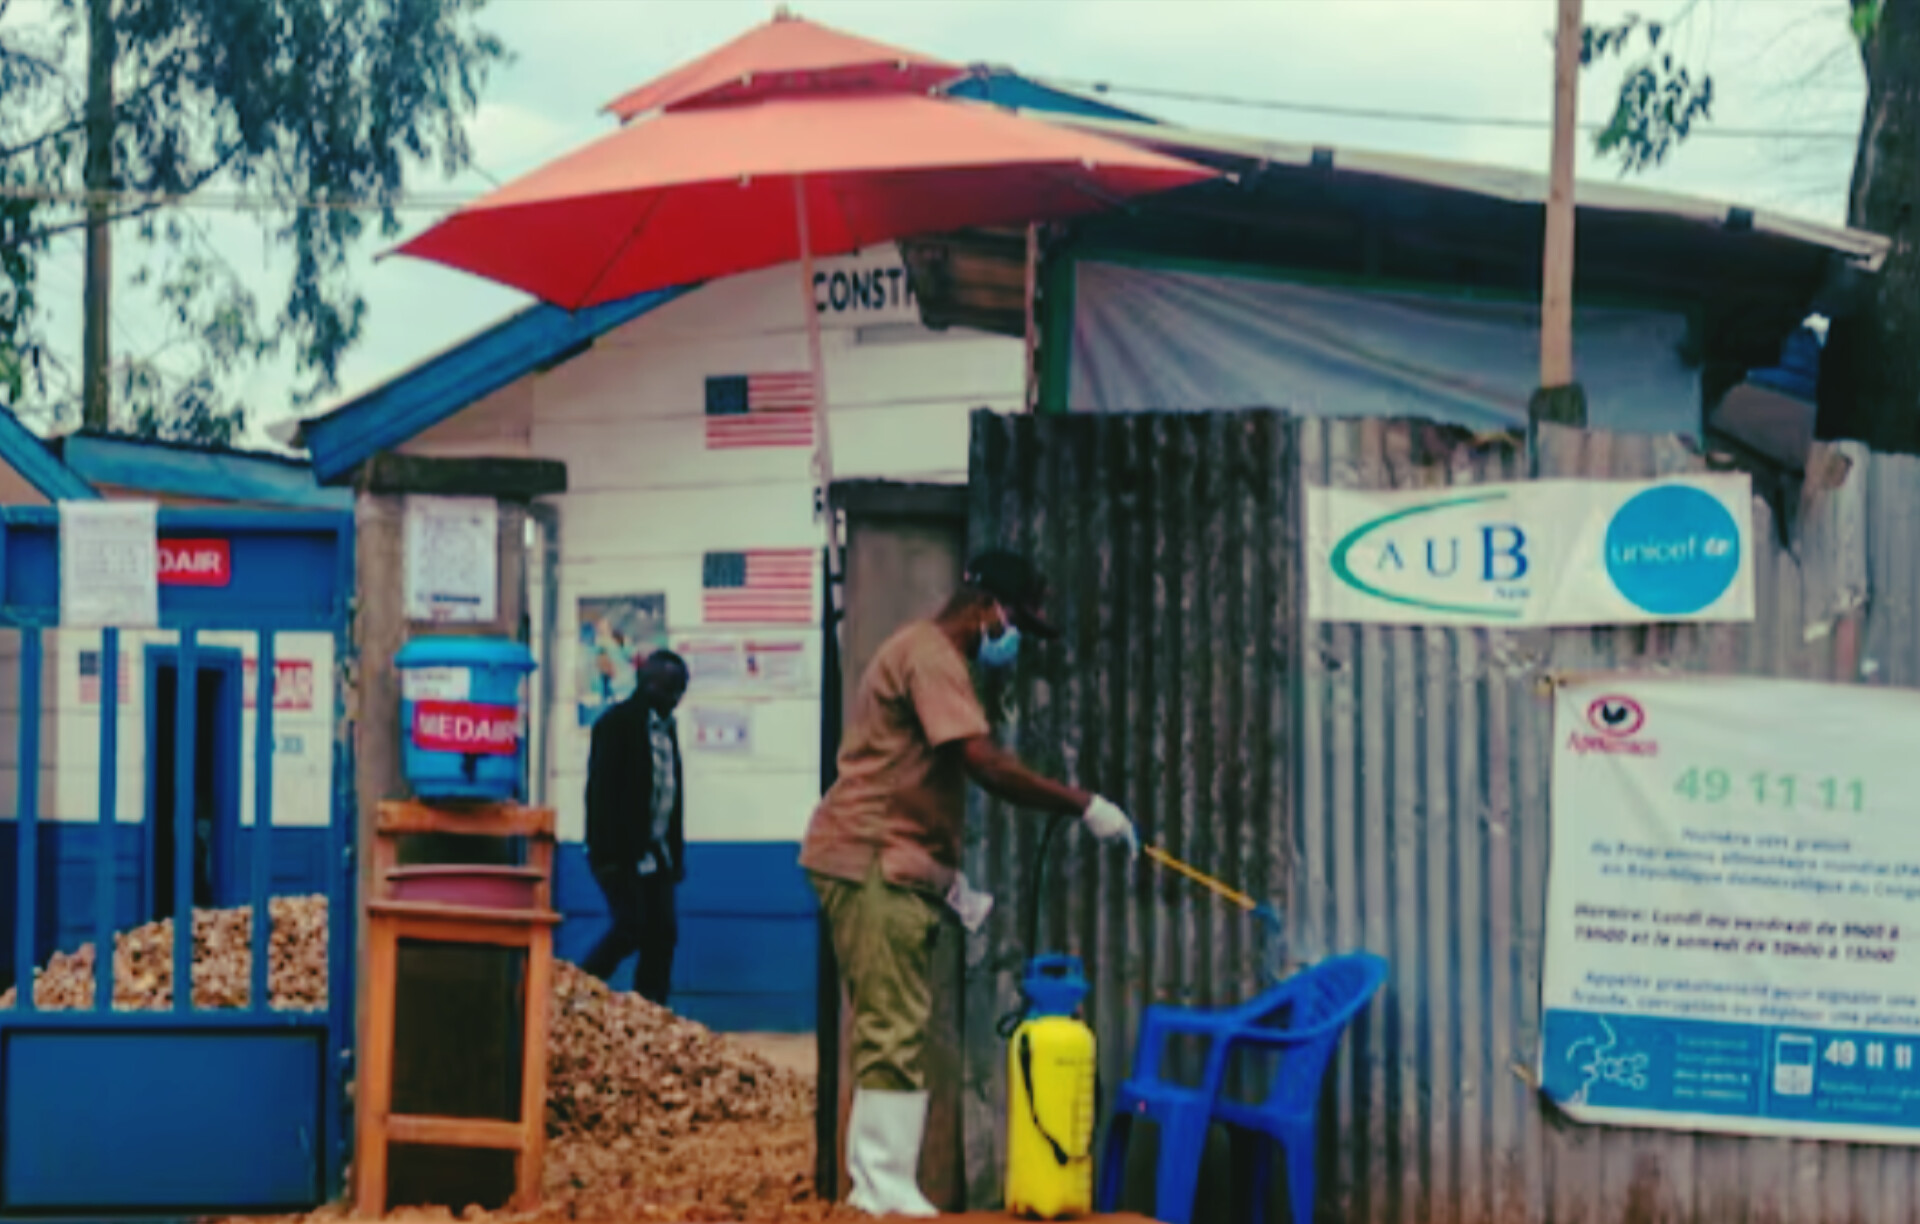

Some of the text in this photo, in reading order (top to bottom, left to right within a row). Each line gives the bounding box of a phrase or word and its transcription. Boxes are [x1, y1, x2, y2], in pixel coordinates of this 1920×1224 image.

[1610, 533, 1697, 564] unicef
[418, 711, 518, 742] MEDAIR
[1672, 766, 1864, 813] 49 11 11
[1823, 1039, 1912, 1070] 49 11 11
